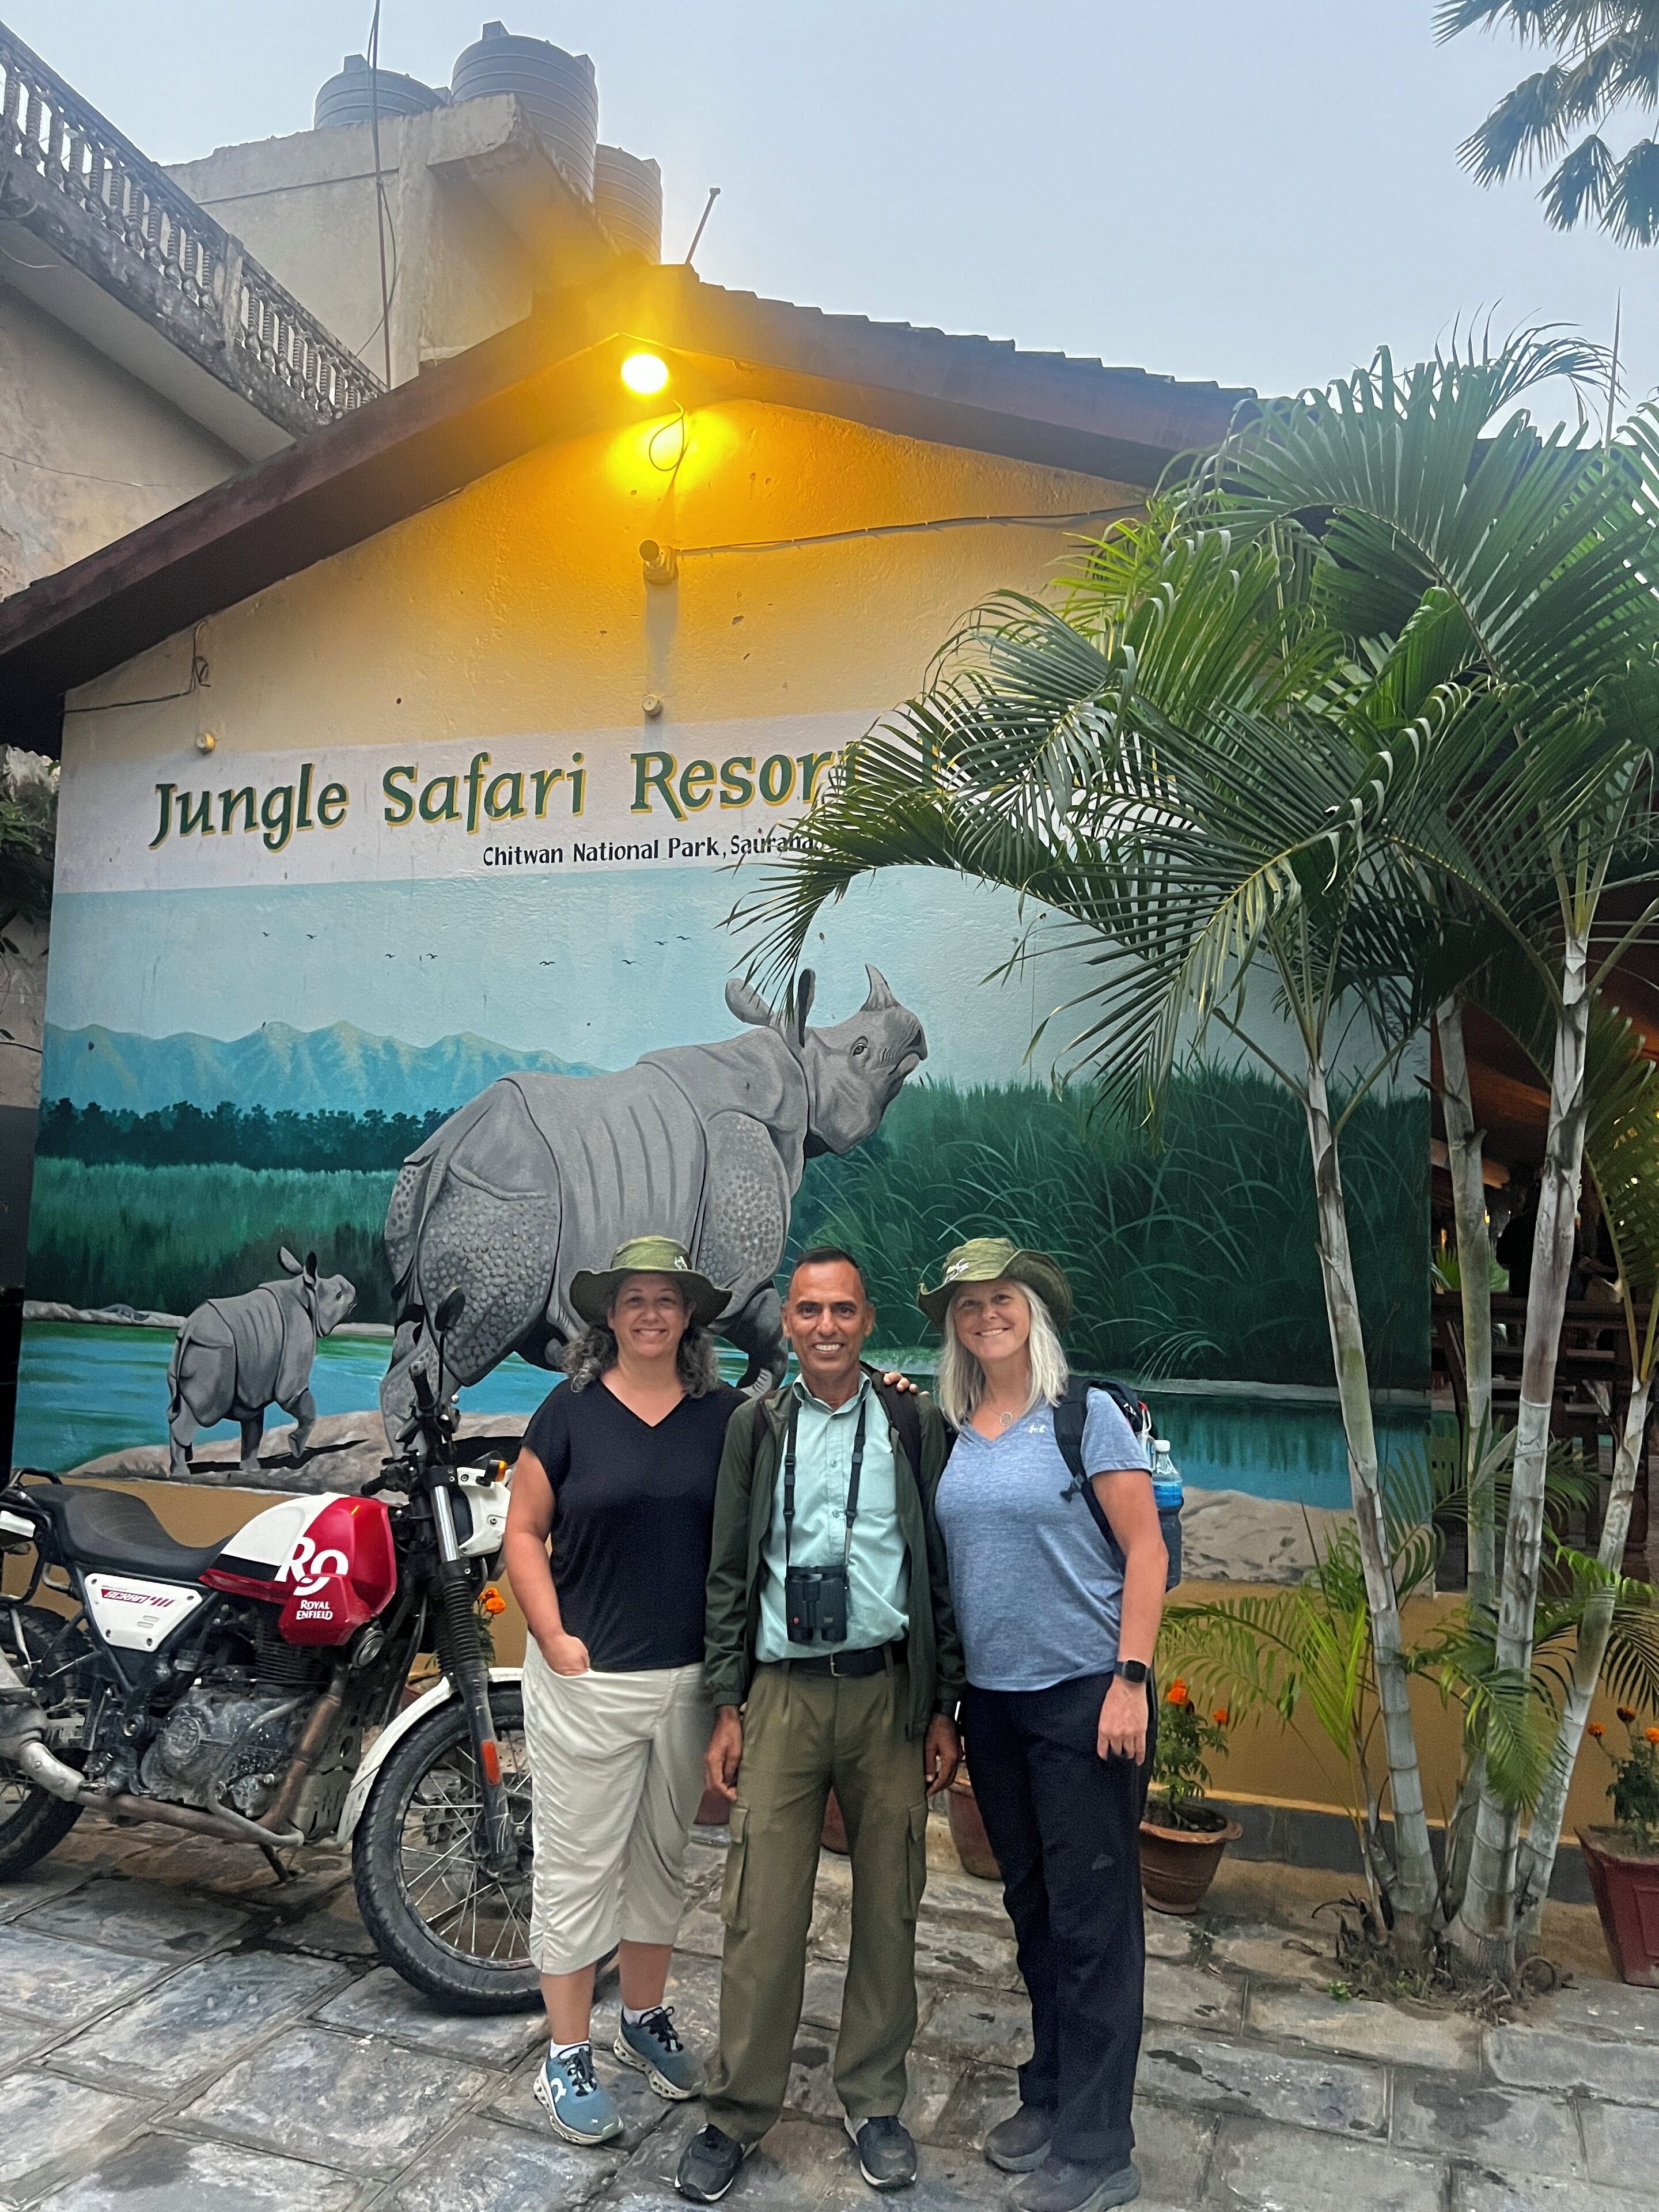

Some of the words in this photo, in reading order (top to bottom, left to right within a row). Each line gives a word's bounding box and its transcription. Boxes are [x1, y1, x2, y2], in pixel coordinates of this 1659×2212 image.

[148, 763, 349, 853] Jungle
[382, 751, 586, 835] Safari
[483, 846, 563, 866] Chitwan
[573, 839, 659, 862] National
[300, 1599, 330, 1610] ROYAL
[296, 1610, 334, 1620] ENFIELD
